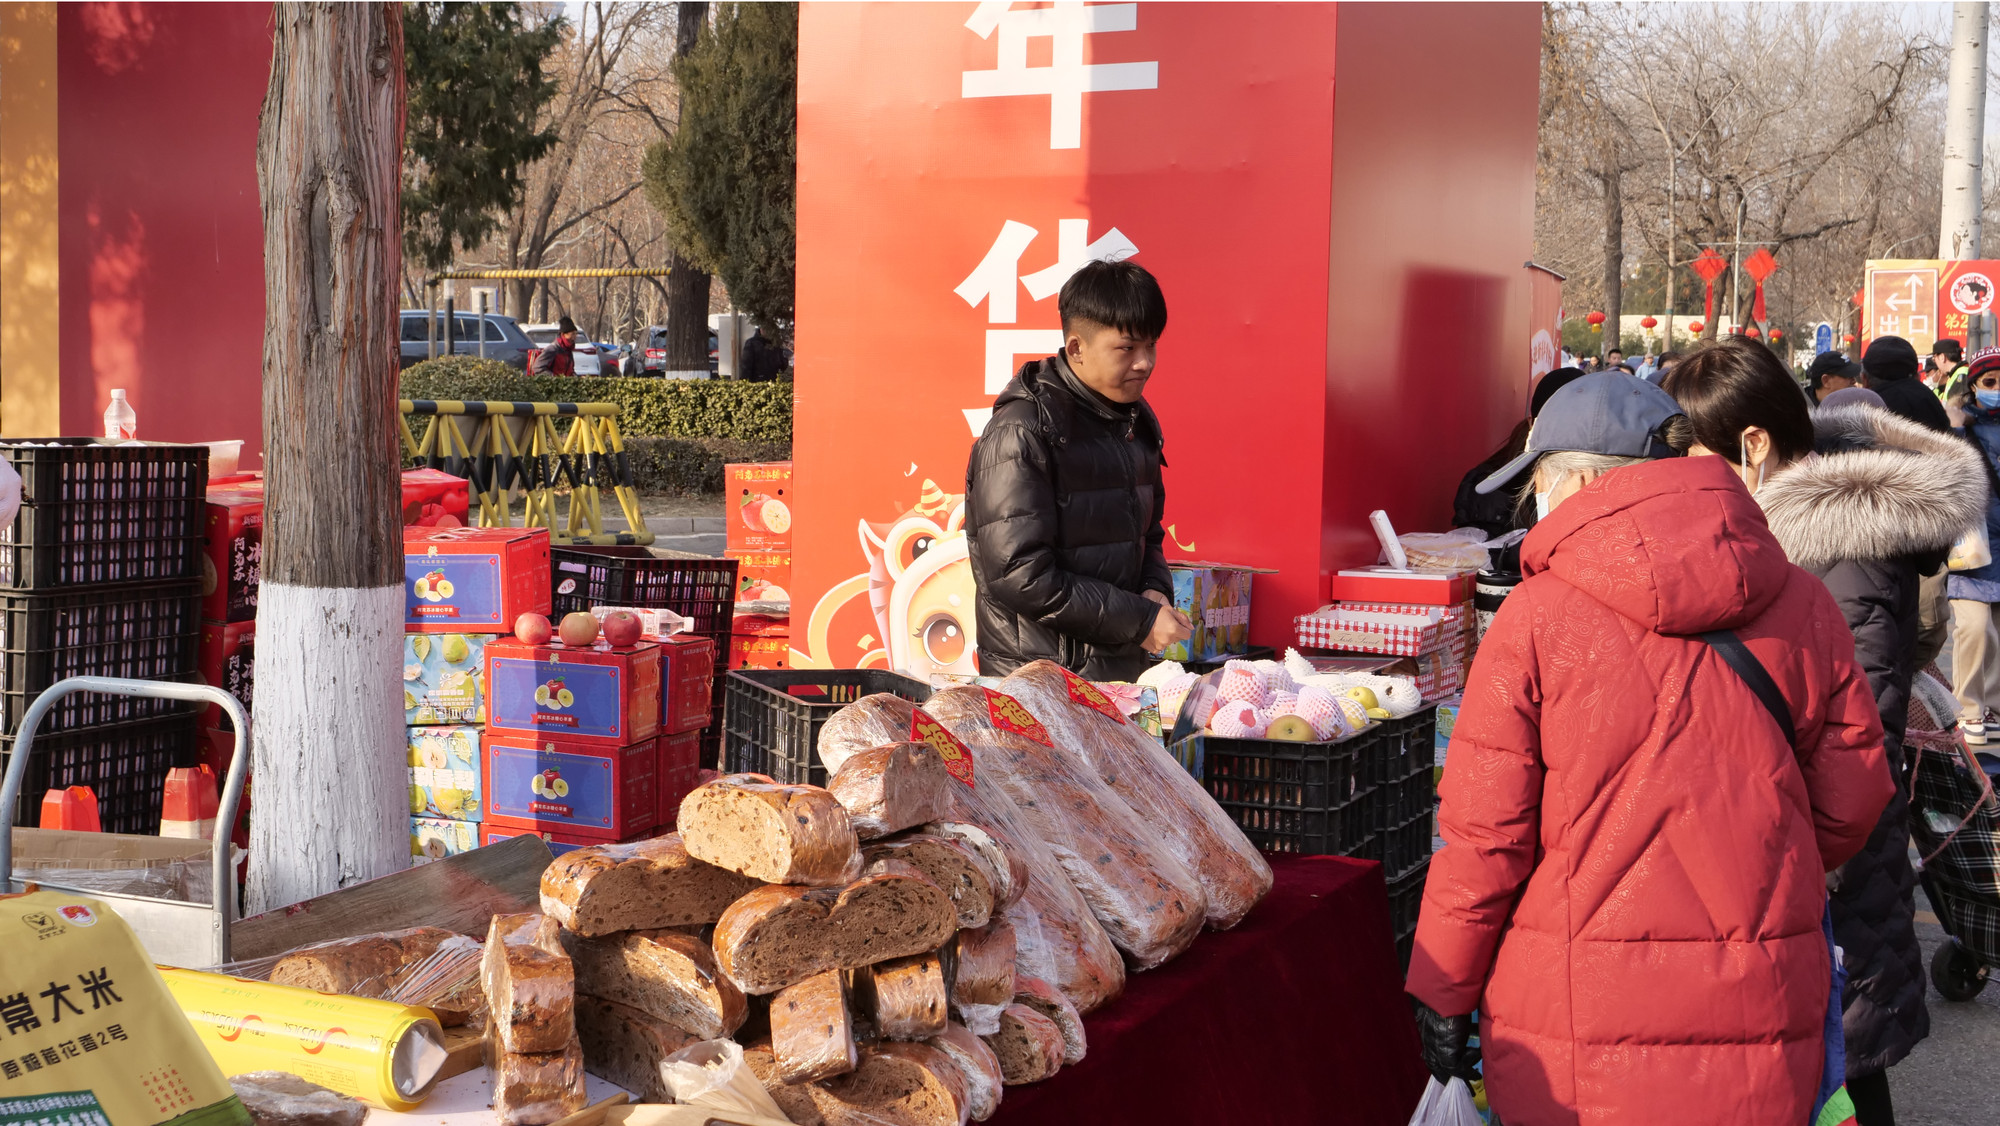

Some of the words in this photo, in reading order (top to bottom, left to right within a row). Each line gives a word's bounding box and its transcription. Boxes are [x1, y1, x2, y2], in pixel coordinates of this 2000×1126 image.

[1880, 314, 1928, 335] 出口
[234, 537, 246, 581] 阿克苏
[1069, 676, 1109, 704] 福
[991, 694, 1035, 728] 福
[916, 722, 963, 762] 福
[1, 1023, 128, 1080] 原粮稻花香2号
